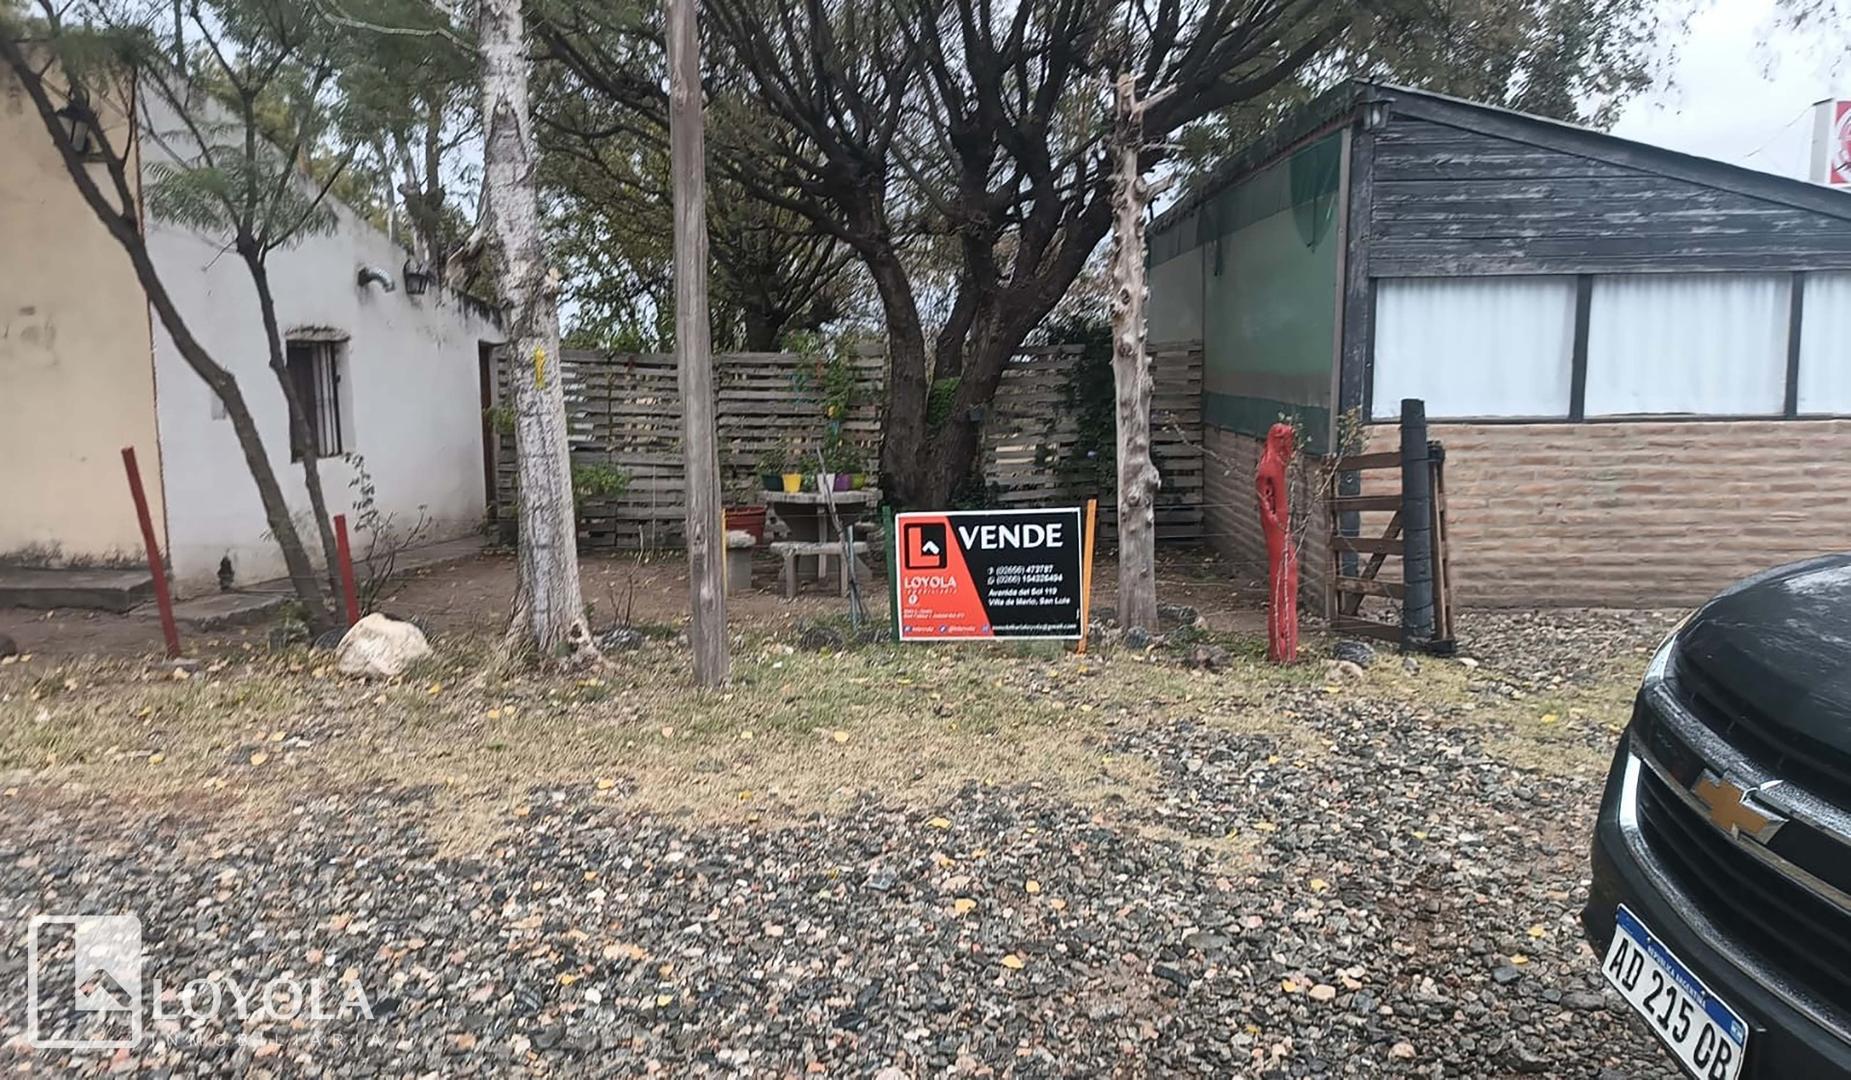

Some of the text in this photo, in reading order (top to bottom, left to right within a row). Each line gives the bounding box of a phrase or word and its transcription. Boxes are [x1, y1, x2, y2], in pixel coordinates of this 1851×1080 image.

[958, 523, 1063, 550] VENDE
[904, 576, 957, 590] LOYOLA
[988, 588, 1017, 597] Avenida
[1018, 588, 1030, 596] del
[988, 598, 1004, 607] Villa
[1005, 598, 1015, 606] de
[1039, 597, 1054, 605] San
[1054, 596, 1071, 605] Luis
[1676, 973, 1706, 1009] ARGENTINA
[1609, 938, 1732, 1080] AD 215 CB
